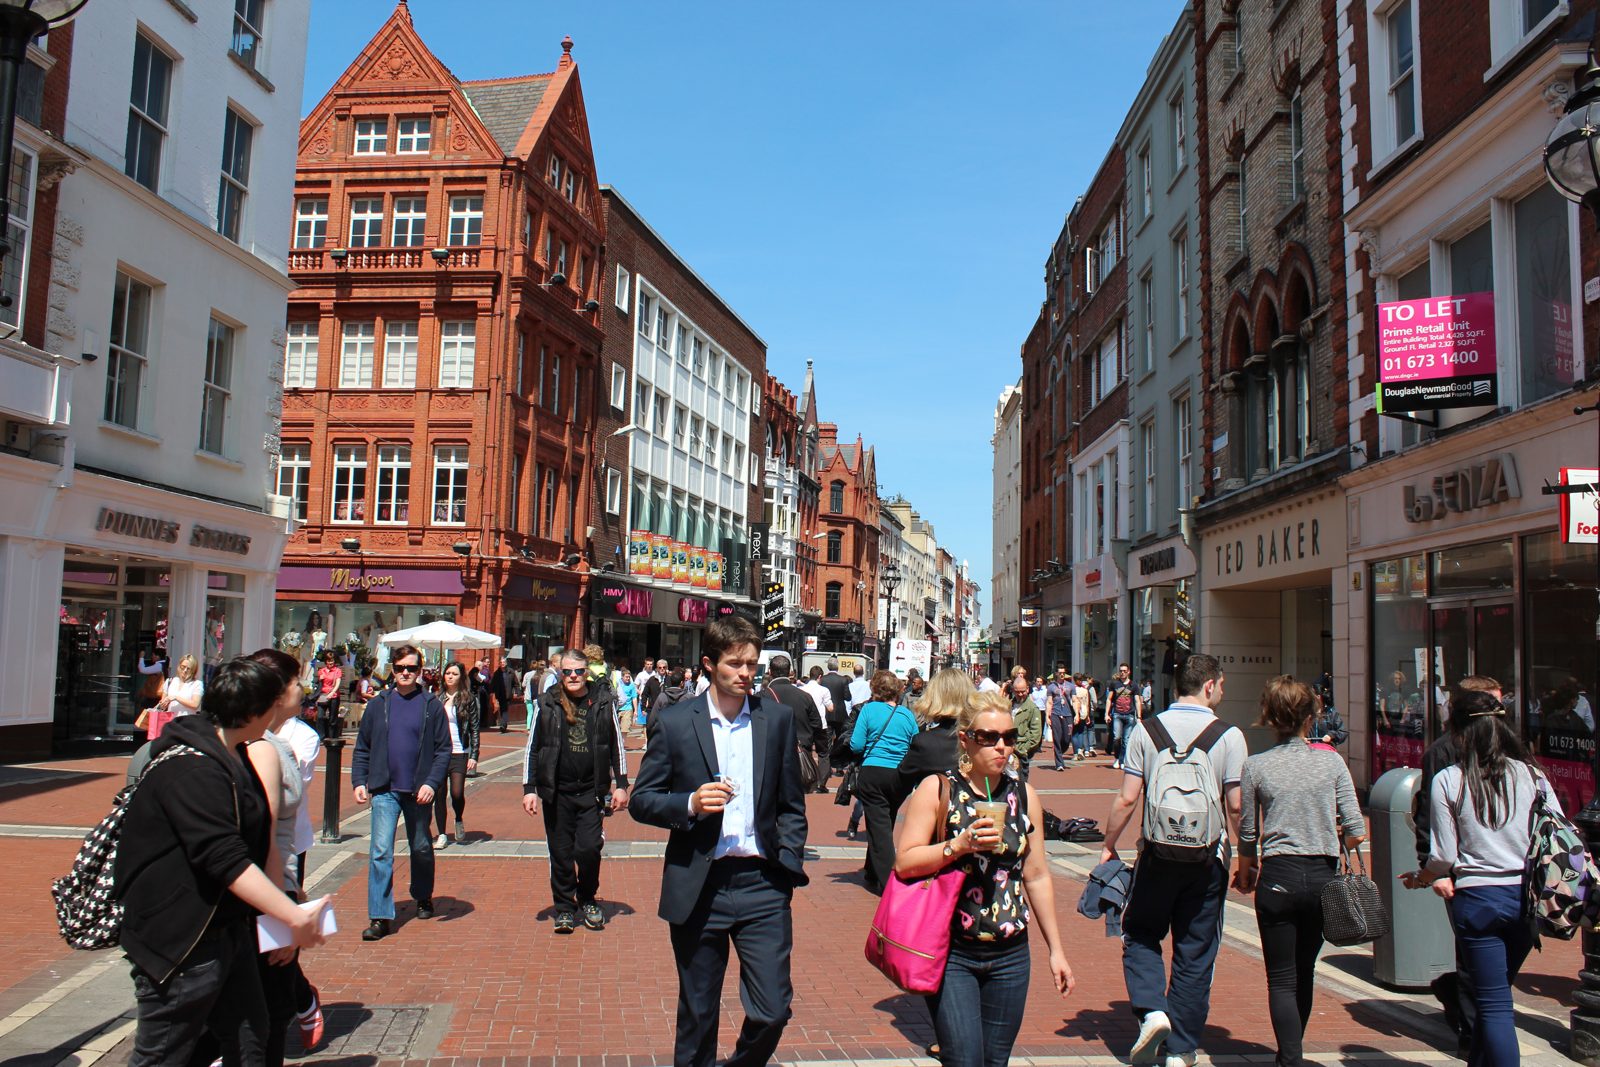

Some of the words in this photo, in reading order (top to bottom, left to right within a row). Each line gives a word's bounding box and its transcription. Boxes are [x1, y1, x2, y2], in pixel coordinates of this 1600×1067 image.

[1383, 304, 1415, 322] TO
[1424, 298, 1466, 318] LET
[1383, 327, 1413, 338] Prime
[1416, 322, 1444, 334] Retail
[1448, 320, 1470, 331] Unit
[1383, 338, 1403, 346] Entire
[1403, 336, 1427, 344] Building
[1430, 333, 1445, 341] Total
[1384, 345, 1408, 353] Ground
[1418, 342, 1436, 350] Retail
[1384, 358, 1401, 371] 01
[1407, 354, 1435, 369] 673
[1441, 350, 1479, 366] 1400
[1385, 382, 1472, 398] DouglasNewmanGood
[1424, 392, 1451, 400] Commercial
[96, 507, 181, 544] DUNNES
[752, 531, 762, 559] next
[1216, 540, 1243, 576] TED
[1257, 518, 1320, 568] BAKER
[331, 568, 395, 591] Monsoon
[733, 561, 741, 587] next
[603, 588, 624, 597] HMV
[1549, 735, 1558, 748] 01
[1560, 736, 1574, 749] 673
[1552, 764, 1573, 779] Retail
[1167, 834, 1197, 844] adidas
